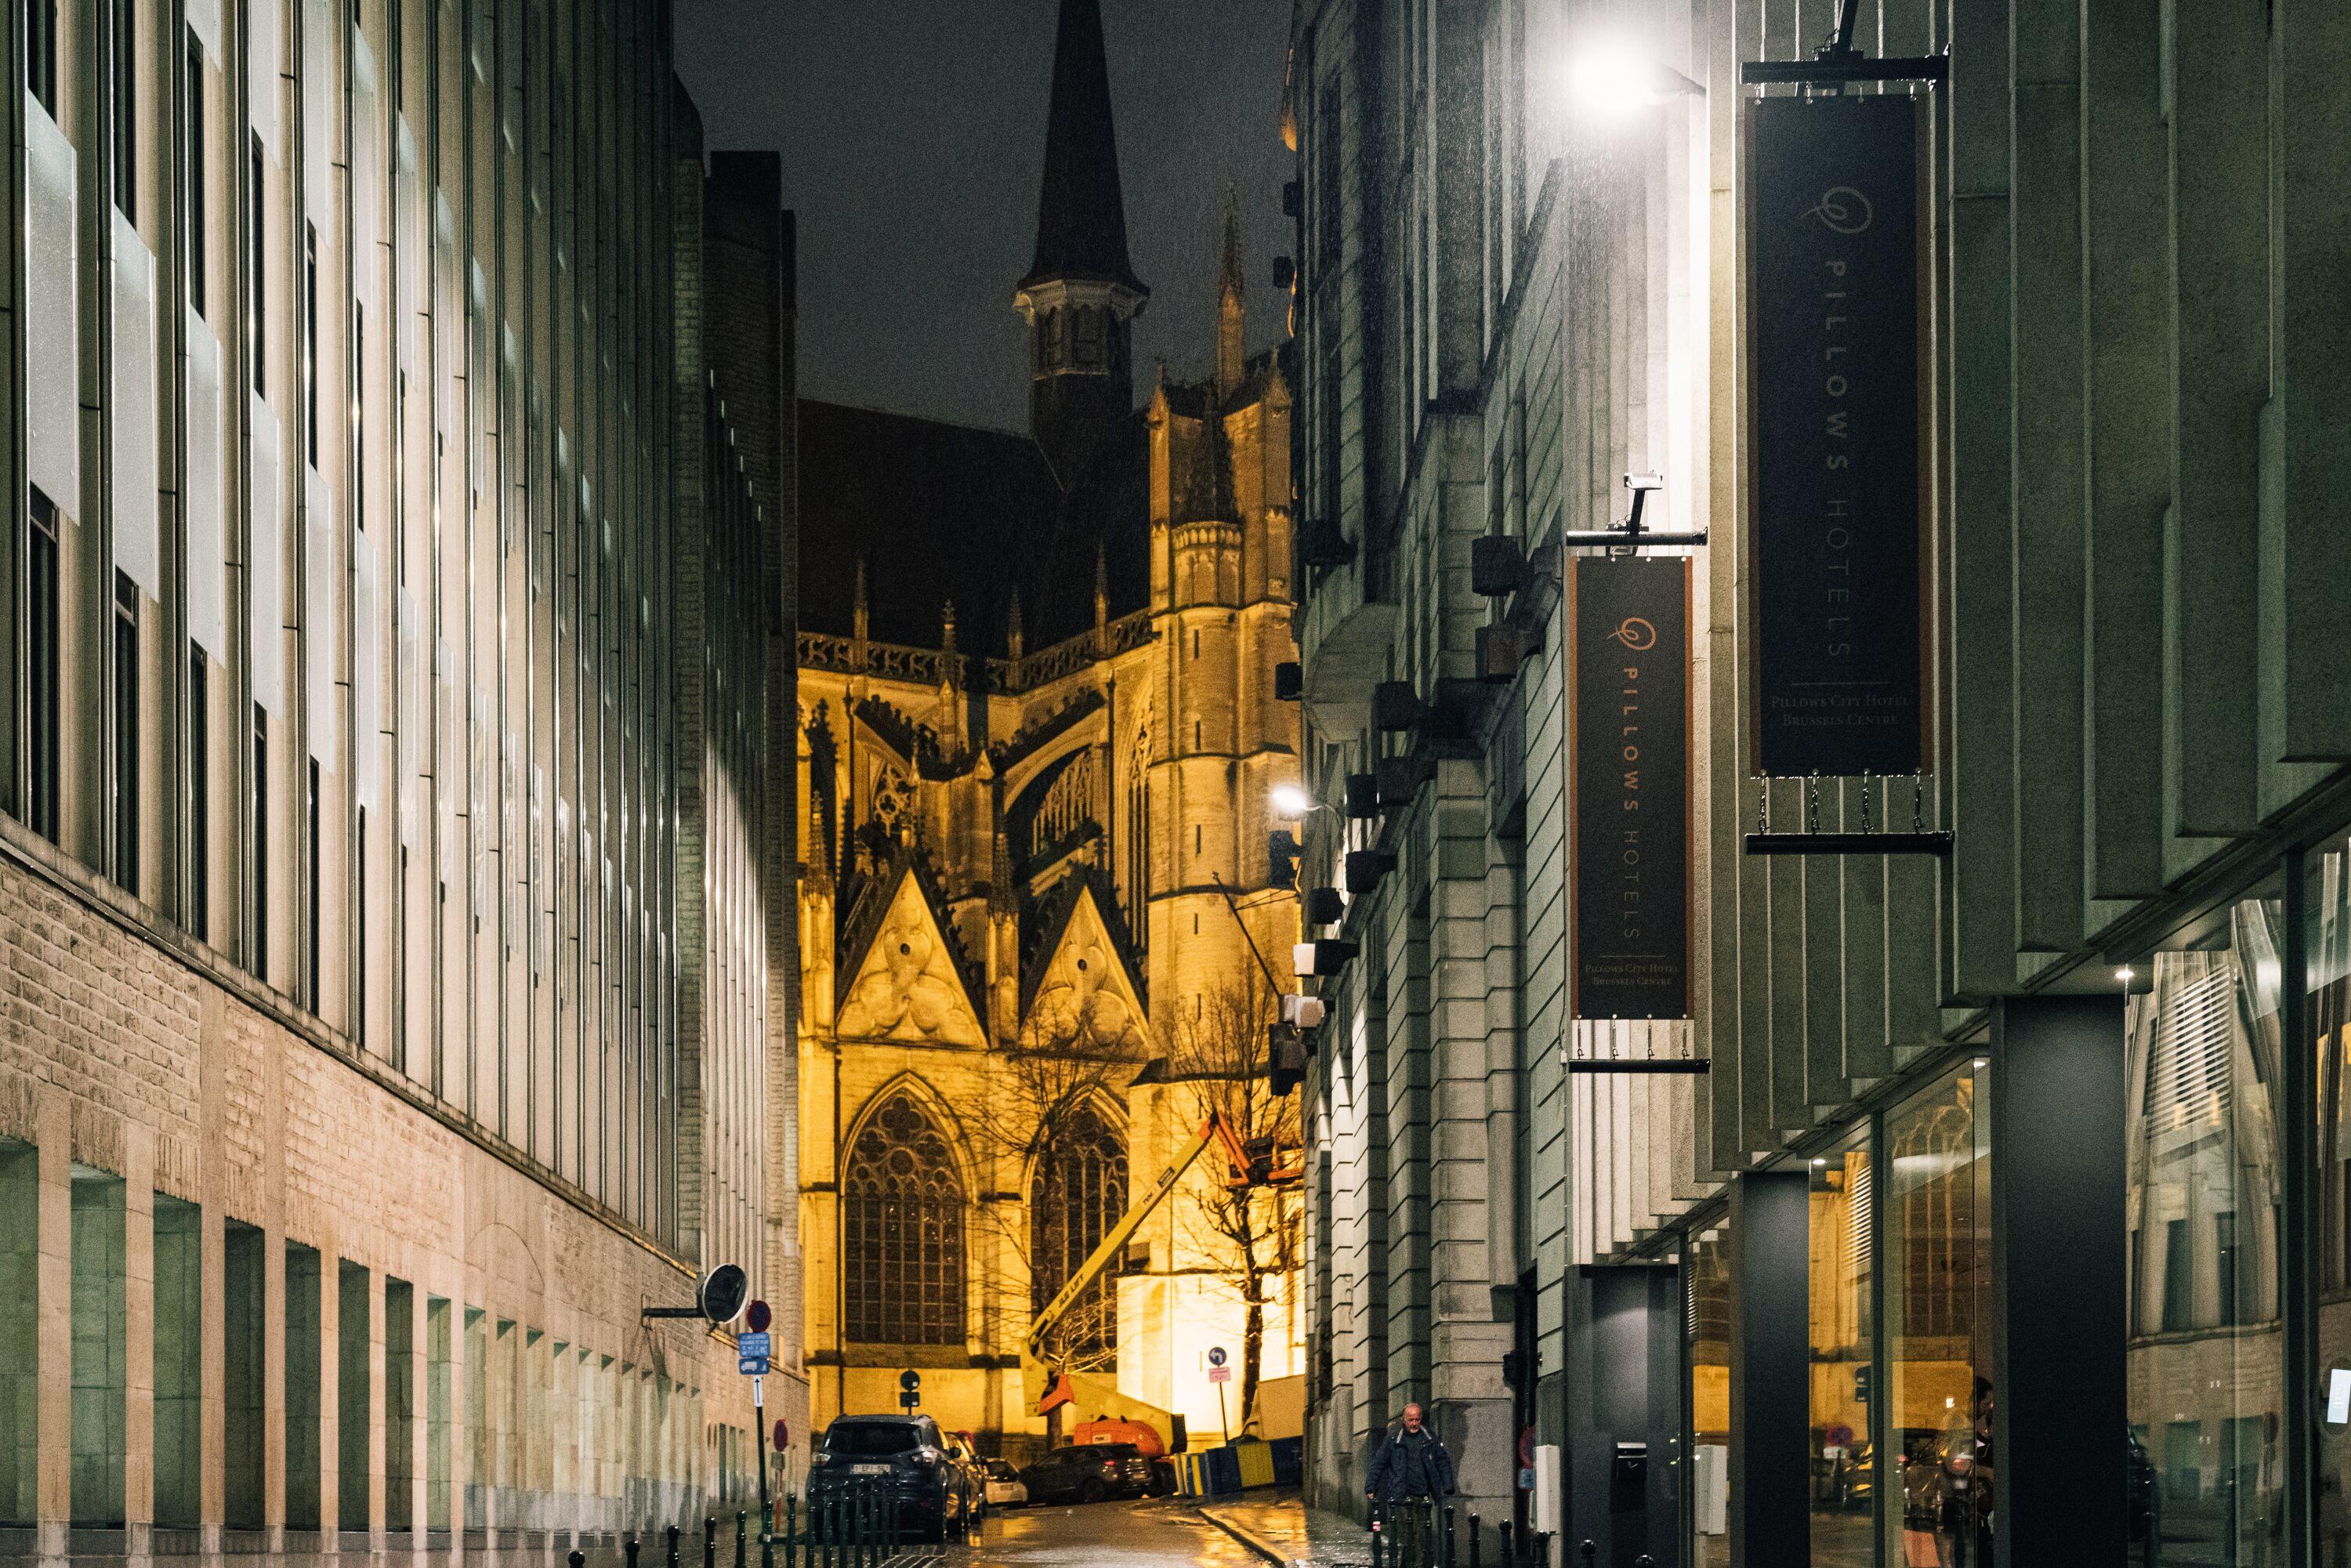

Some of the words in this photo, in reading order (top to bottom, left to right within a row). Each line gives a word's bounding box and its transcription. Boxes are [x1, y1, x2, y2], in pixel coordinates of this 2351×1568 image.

[1824, 259, 1848, 471] PILLOWS
[1826, 499, 1850, 657] HOTELS
[1623, 666, 1639, 811] PILLOWS
[1623, 831, 1640, 939] HOTELS
